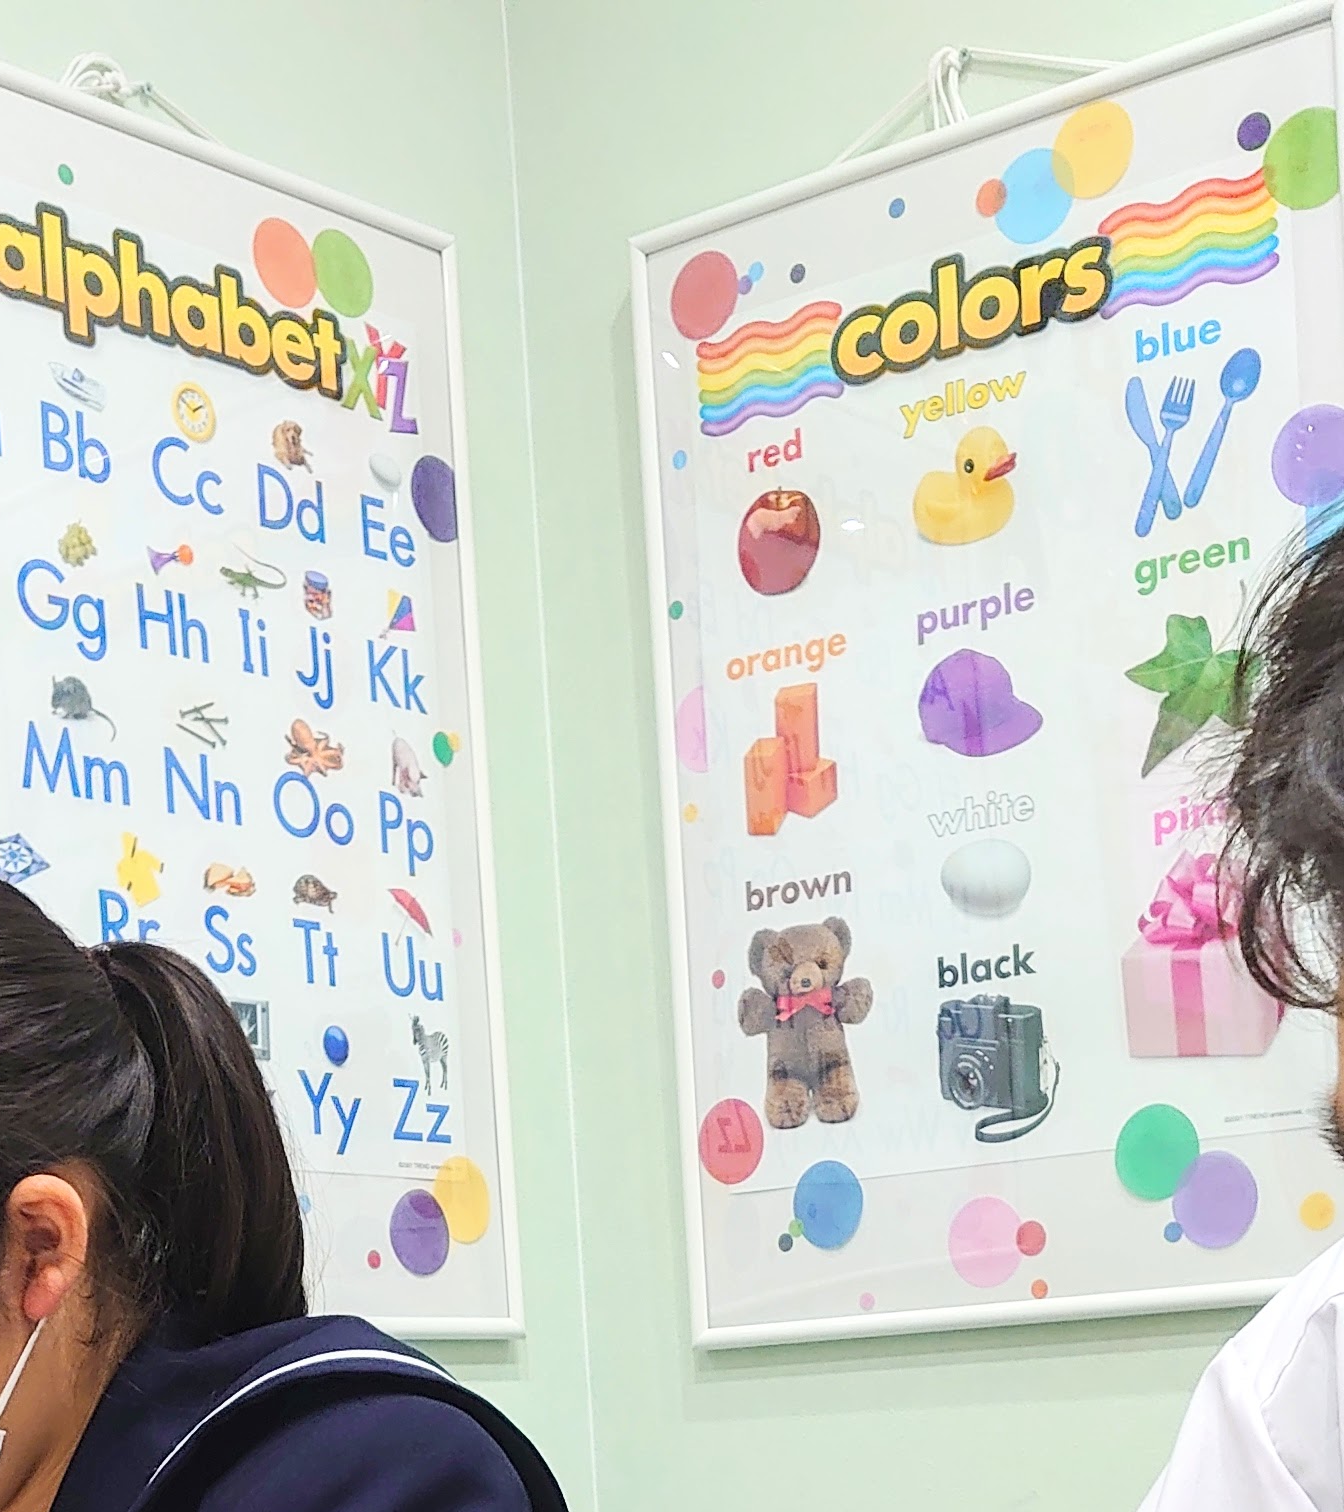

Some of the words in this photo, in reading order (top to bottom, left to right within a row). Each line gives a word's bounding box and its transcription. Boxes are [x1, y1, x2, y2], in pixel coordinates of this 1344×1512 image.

[835, 238, 1113, 383] colors
[1136, 320, 1221, 363] blue
[899, 371, 1026, 442] yellow
[748, 428, 802, 473] red
[41, 401, 110, 483] Bb
[152, 437, 224, 515] Cc
[258, 458, 326, 544] Dd
[360, 489, 420, 567] Ee
[1135, 537, 1250, 596] green
[17, 555, 107, 661] Gg
[136, 583, 209, 663] Hh
[239, 608, 269, 677] Ii
[296, 626, 333, 709] Jj
[368, 640, 427, 714] Kk
[918, 583, 1034, 645] purple
[727, 634, 846, 680] orange
[23, 721, 130, 805] Mm
[164, 747, 242, 826] Nn
[274, 767, 354, 845] Oo
[379, 790, 433, 876] Pp
[928, 791, 1034, 837] white
[746, 872, 851, 911] brown
[95, 885, 165, 948] Rr
[205, 906, 256, 976] Ss
[293, 918, 338, 987] Tt
[382, 933, 443, 1001] Uu
[938, 944, 1036, 988] black
[298, 1070, 361, 1155] Yy
[393, 1073, 451, 1144] Zz
